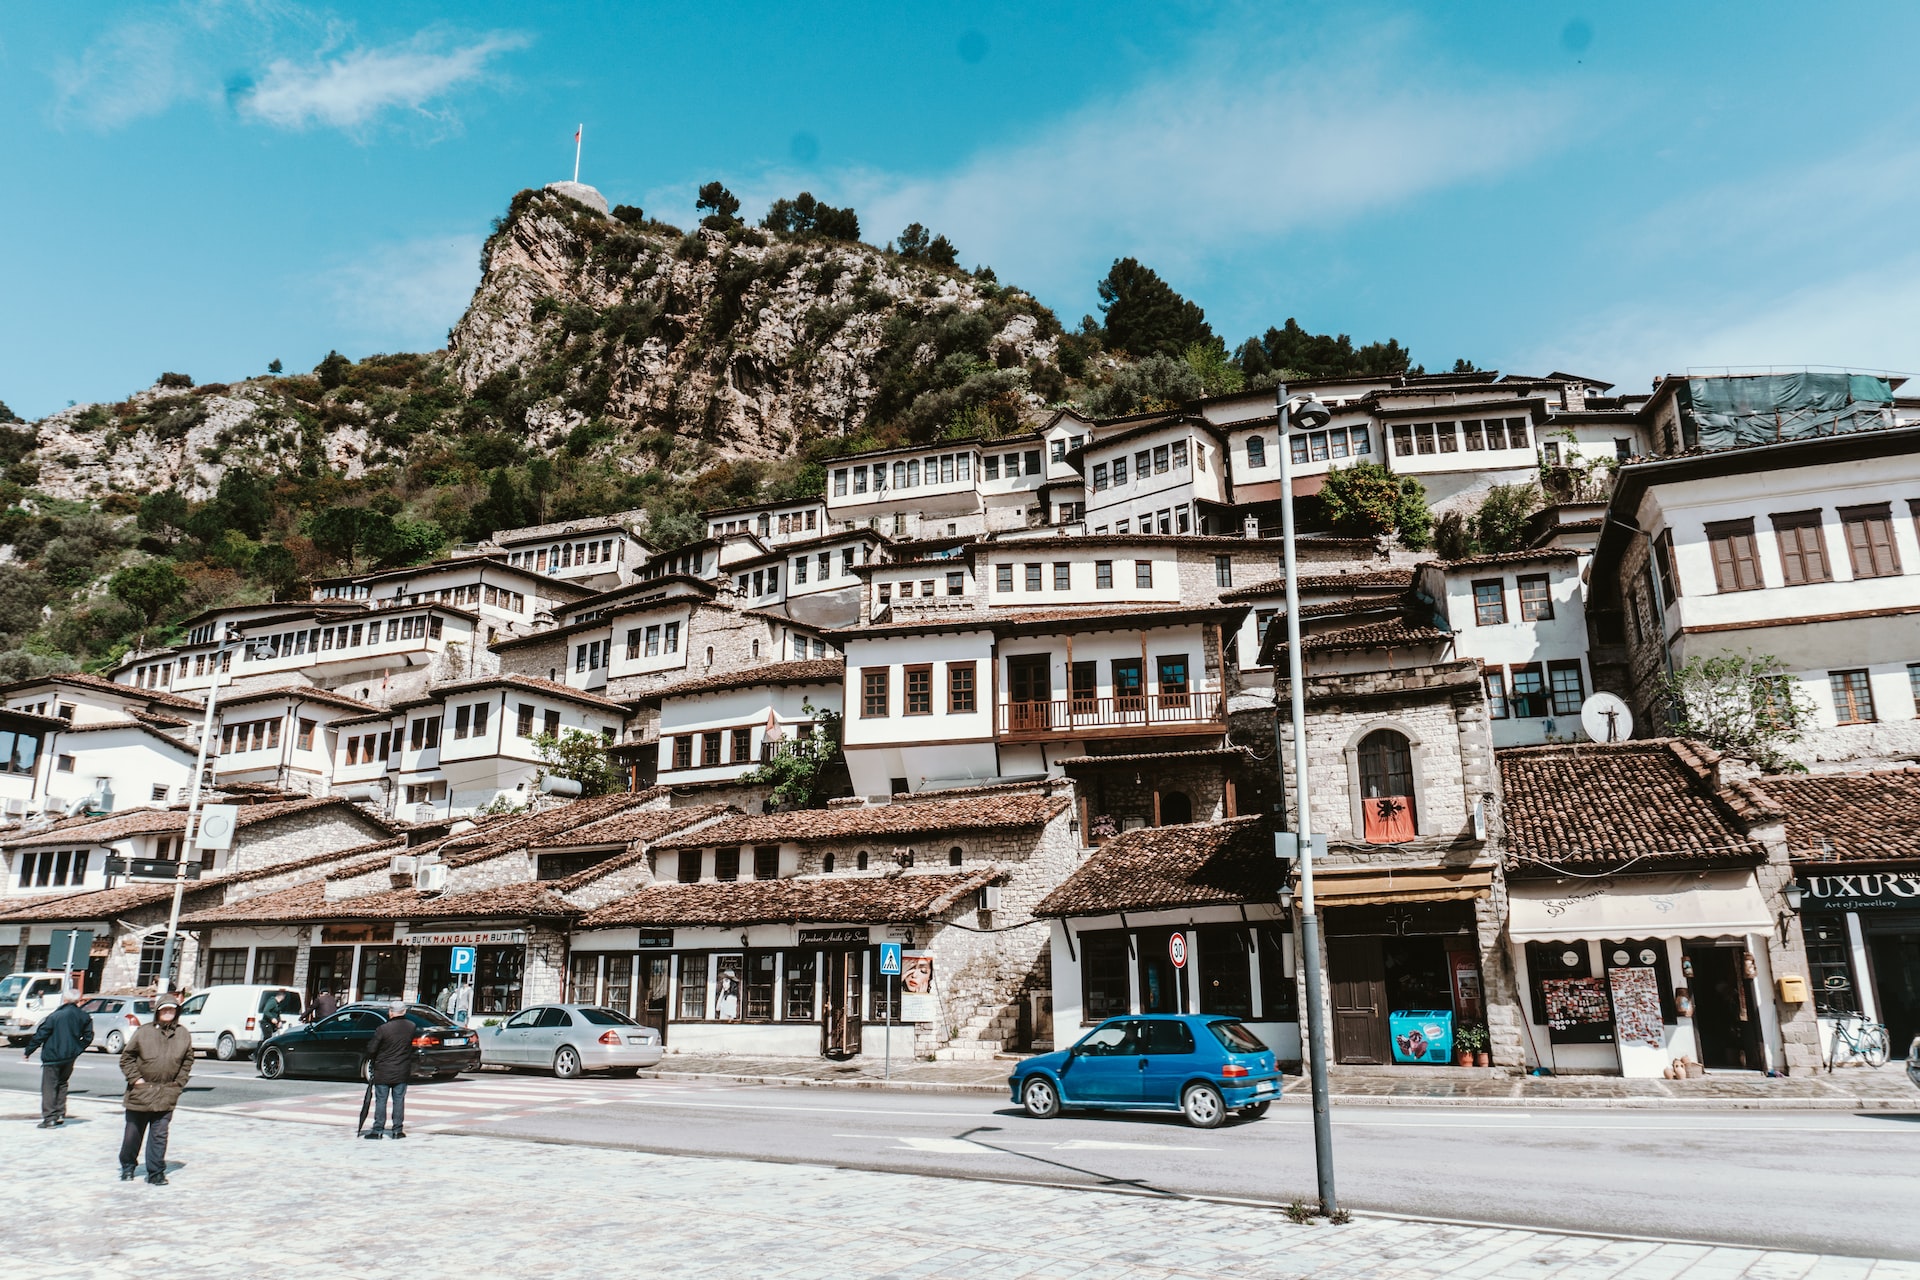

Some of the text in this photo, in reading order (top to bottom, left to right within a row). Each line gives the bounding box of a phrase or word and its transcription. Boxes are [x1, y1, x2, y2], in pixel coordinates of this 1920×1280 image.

[1542, 888, 1605, 918] Souvenir
[1842, 901, 1852, 909] of
[1854, 900, 1898, 909] Jewellery
[412, 936, 432, 944] BUTIK
[433, 934, 489, 943] MANGALEM
[844, 932, 852, 941] &
[1174, 943, 1182, 958] 30
[455, 950, 470, 971] P
